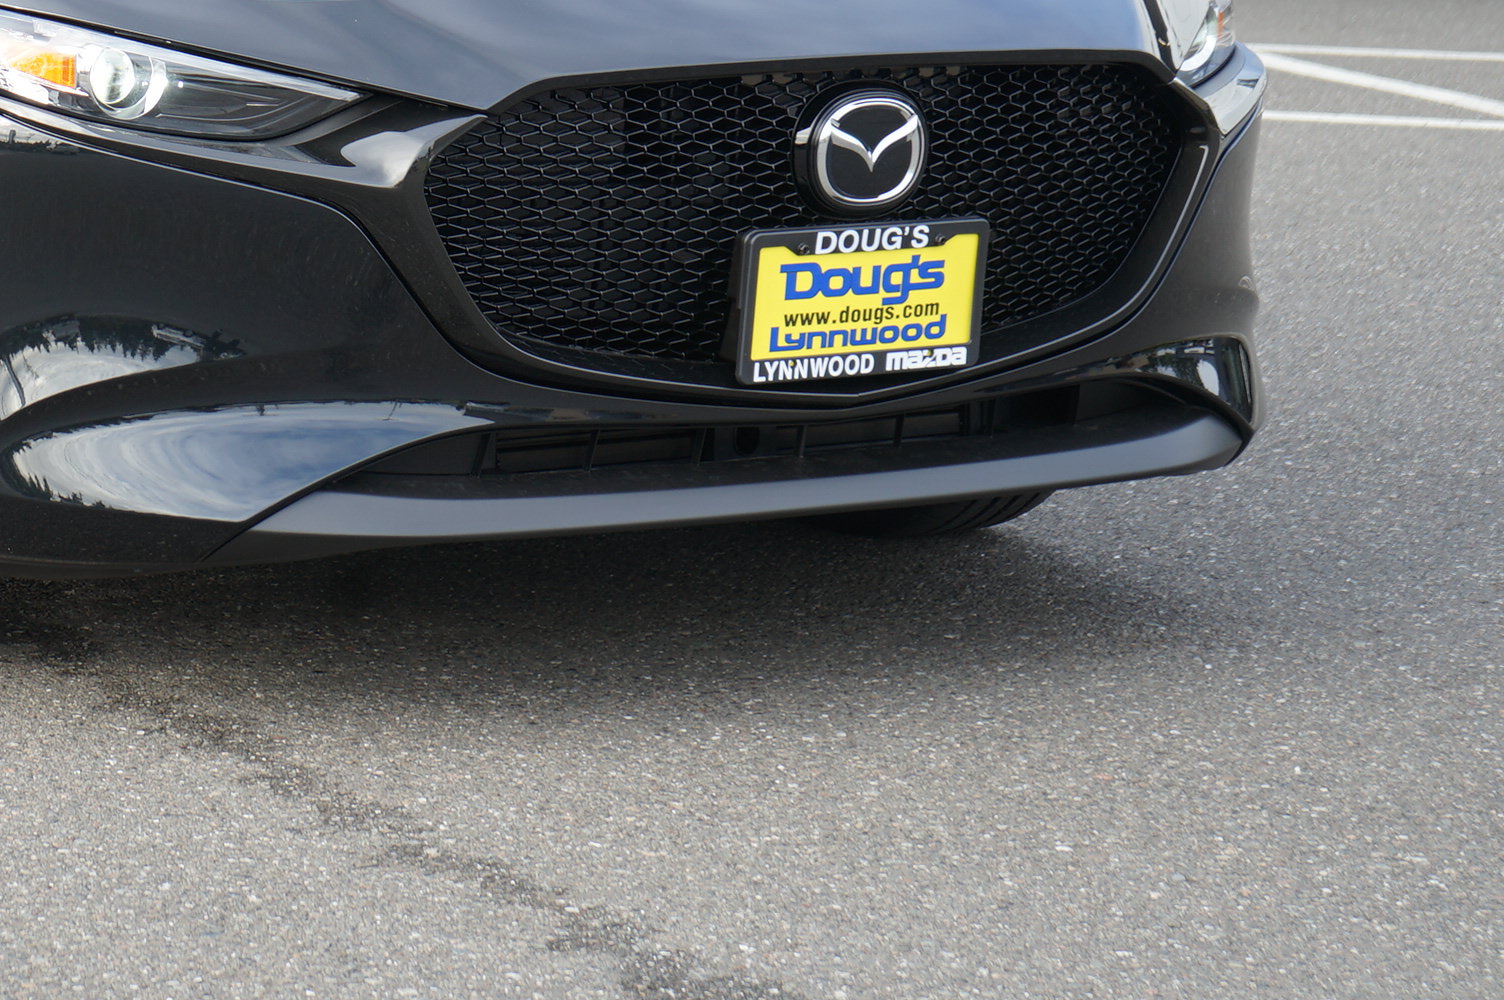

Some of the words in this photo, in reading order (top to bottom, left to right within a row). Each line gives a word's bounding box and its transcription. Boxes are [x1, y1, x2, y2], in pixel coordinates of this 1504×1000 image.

[815, 225, 930, 254] DOUG'S
[780, 254, 946, 306] Doug's
[784, 302, 940, 327] www.dougs.com
[769, 314, 947, 352] Lynnwood
[753, 354, 875, 382] LYNNWOOD
